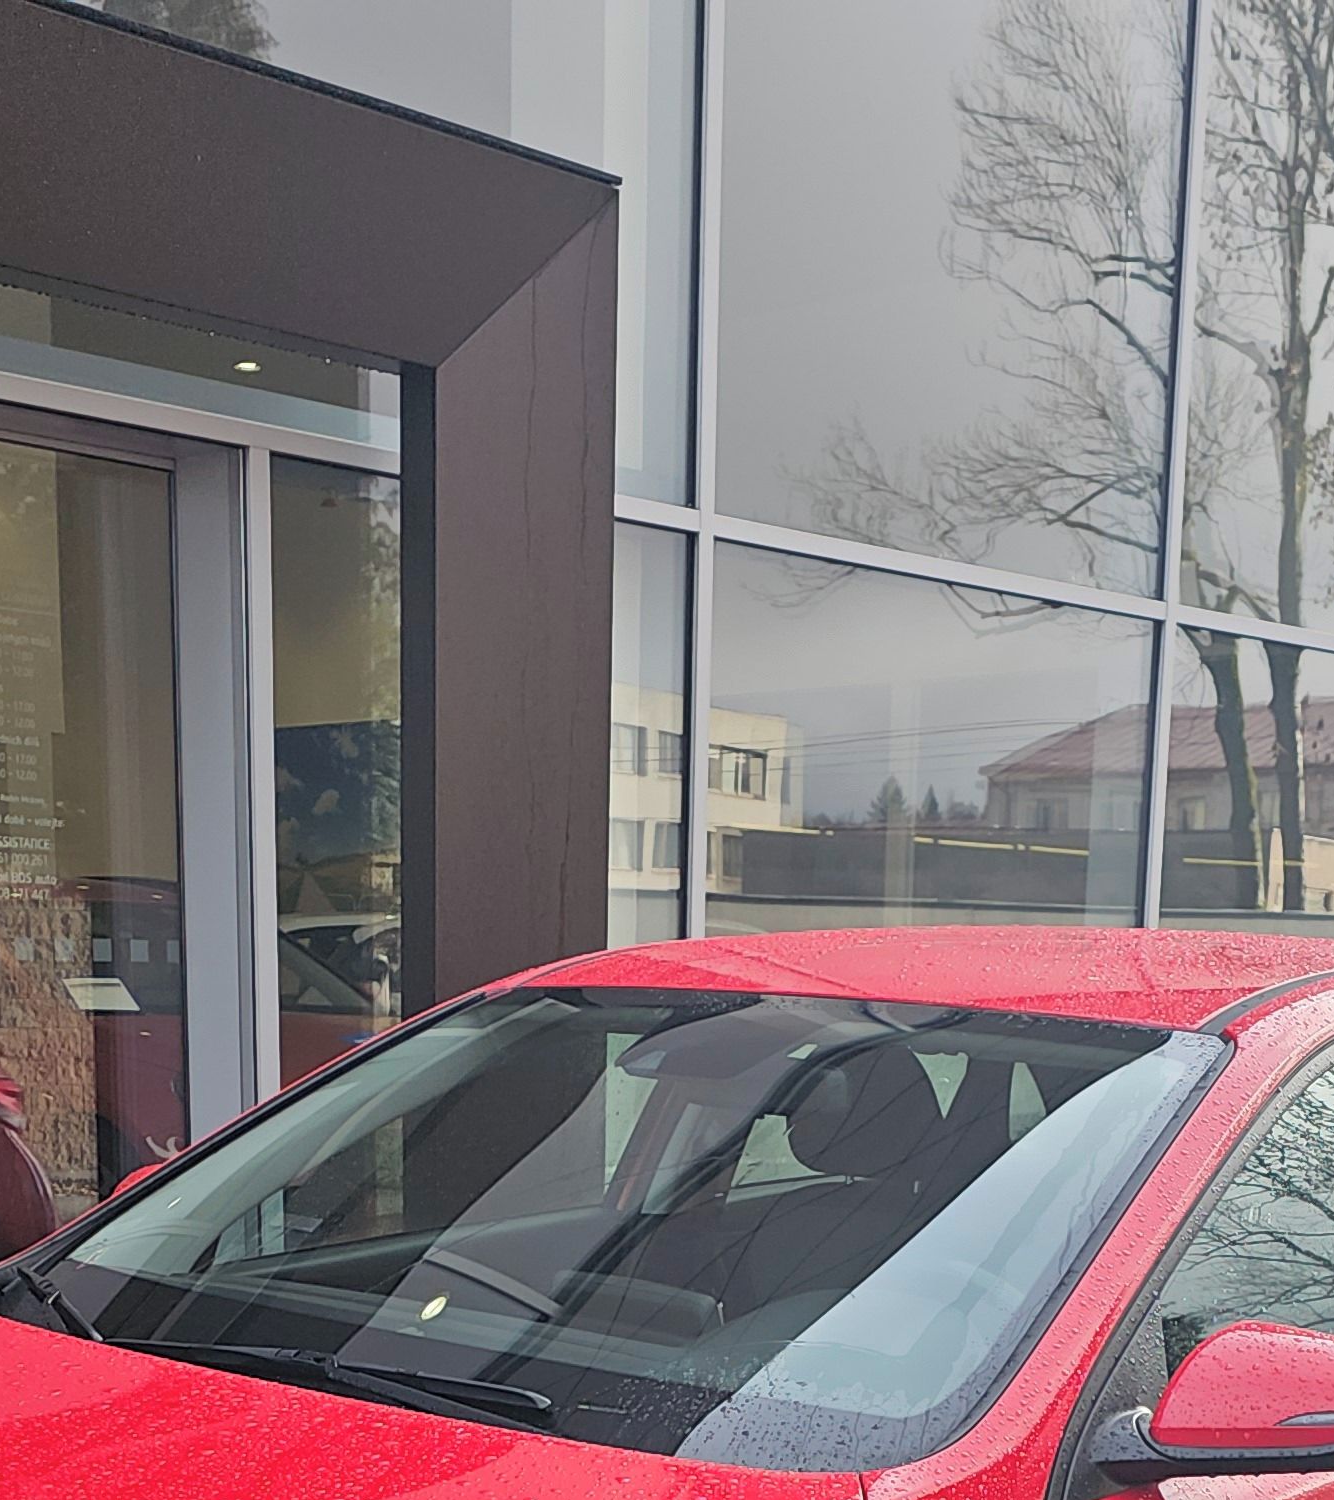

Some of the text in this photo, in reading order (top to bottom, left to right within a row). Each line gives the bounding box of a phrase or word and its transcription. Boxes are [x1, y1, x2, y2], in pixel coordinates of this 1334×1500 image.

[15, 754, 38, 766] 17.00
[15, 770, 38, 781] 12.00
[11, 853, 29, 865] 000
[31, 854, 48, 866] 261
